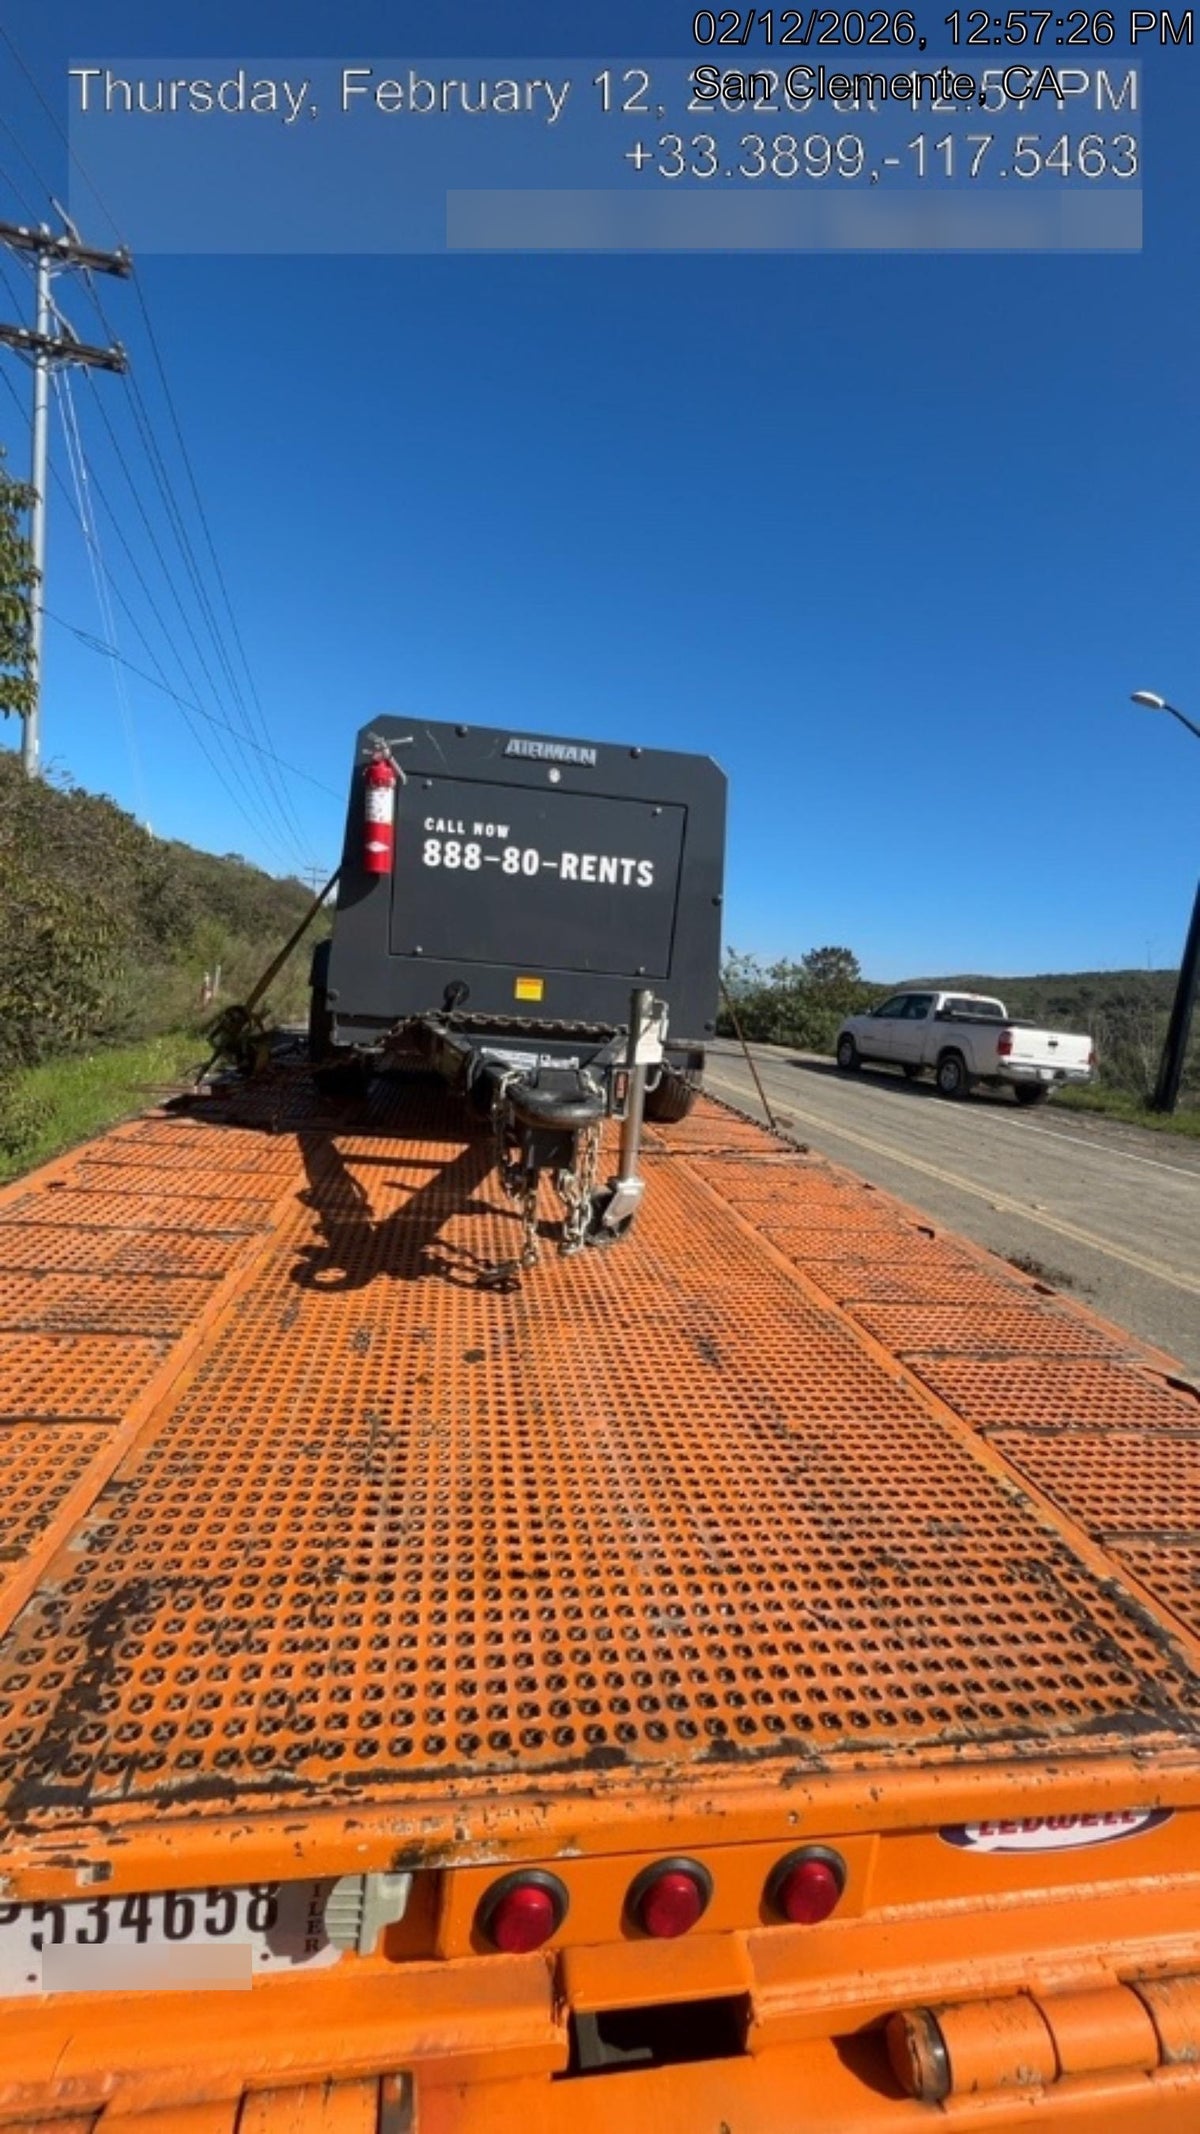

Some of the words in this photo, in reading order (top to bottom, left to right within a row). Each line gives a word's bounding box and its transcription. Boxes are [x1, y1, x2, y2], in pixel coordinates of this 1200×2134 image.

[504, 738, 597, 767] AIRMAN
[424, 817, 466, 835] CALL
[473, 822, 510, 839] NOW
[422, 838, 655, 888] 888-80-RENTS
